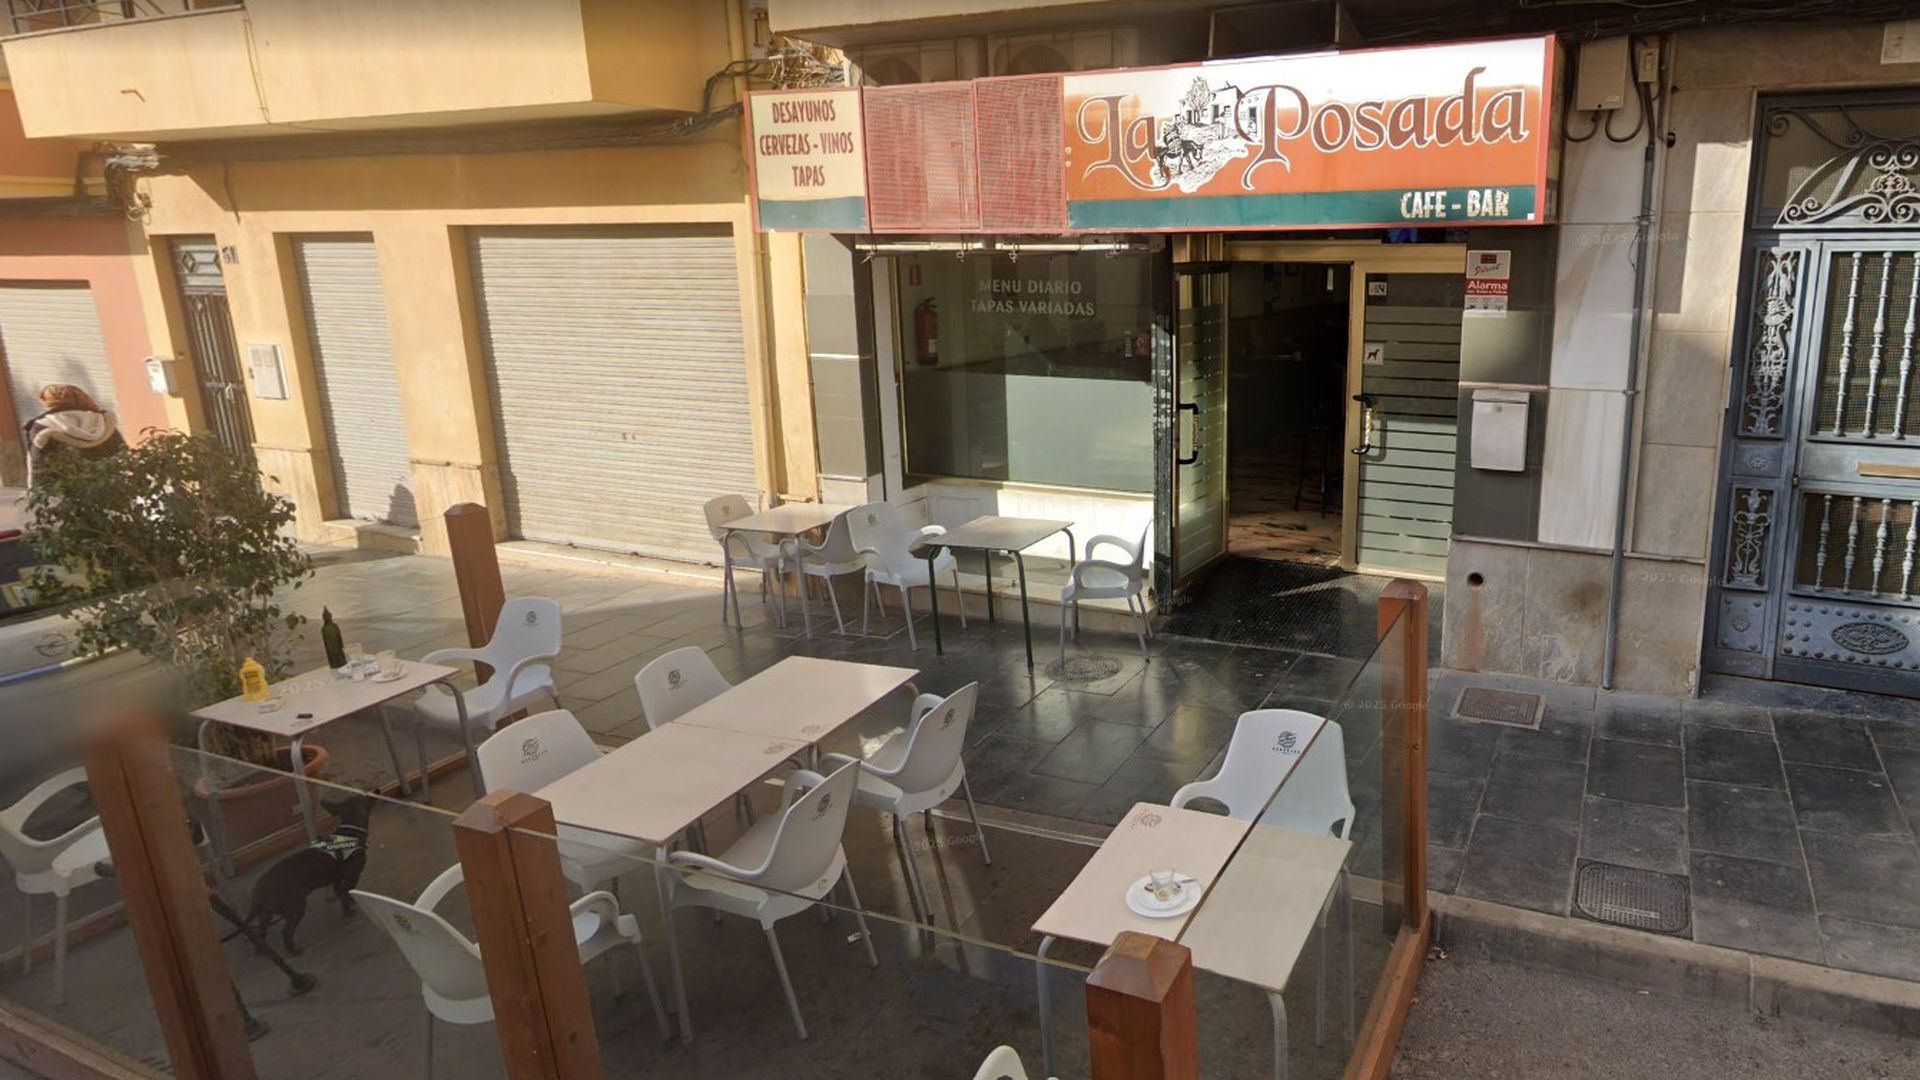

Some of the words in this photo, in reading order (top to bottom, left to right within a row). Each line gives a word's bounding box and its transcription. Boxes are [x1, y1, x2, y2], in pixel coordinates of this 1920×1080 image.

[772, 100, 837, 124] DESAYUNOS
[1076, 92, 1172, 192] La
[1233, 66, 1531, 193] Posada
[759, 132, 811, 156] CERVEZAS
[819, 131, 854, 154] VINOS
[791, 165, 826, 187] TAPAS
[1400, 190, 1447, 219] CAFE
[1467, 188, 1510, 217] BAR
[979, 279, 1022, 293] MENU
[1028, 280, 1082, 295] DIARIO
[1467, 280, 1508, 290] Alarma
[970, 299, 1014, 313] TAPAS
[1019, 299, 1094, 316] VARIADAS
